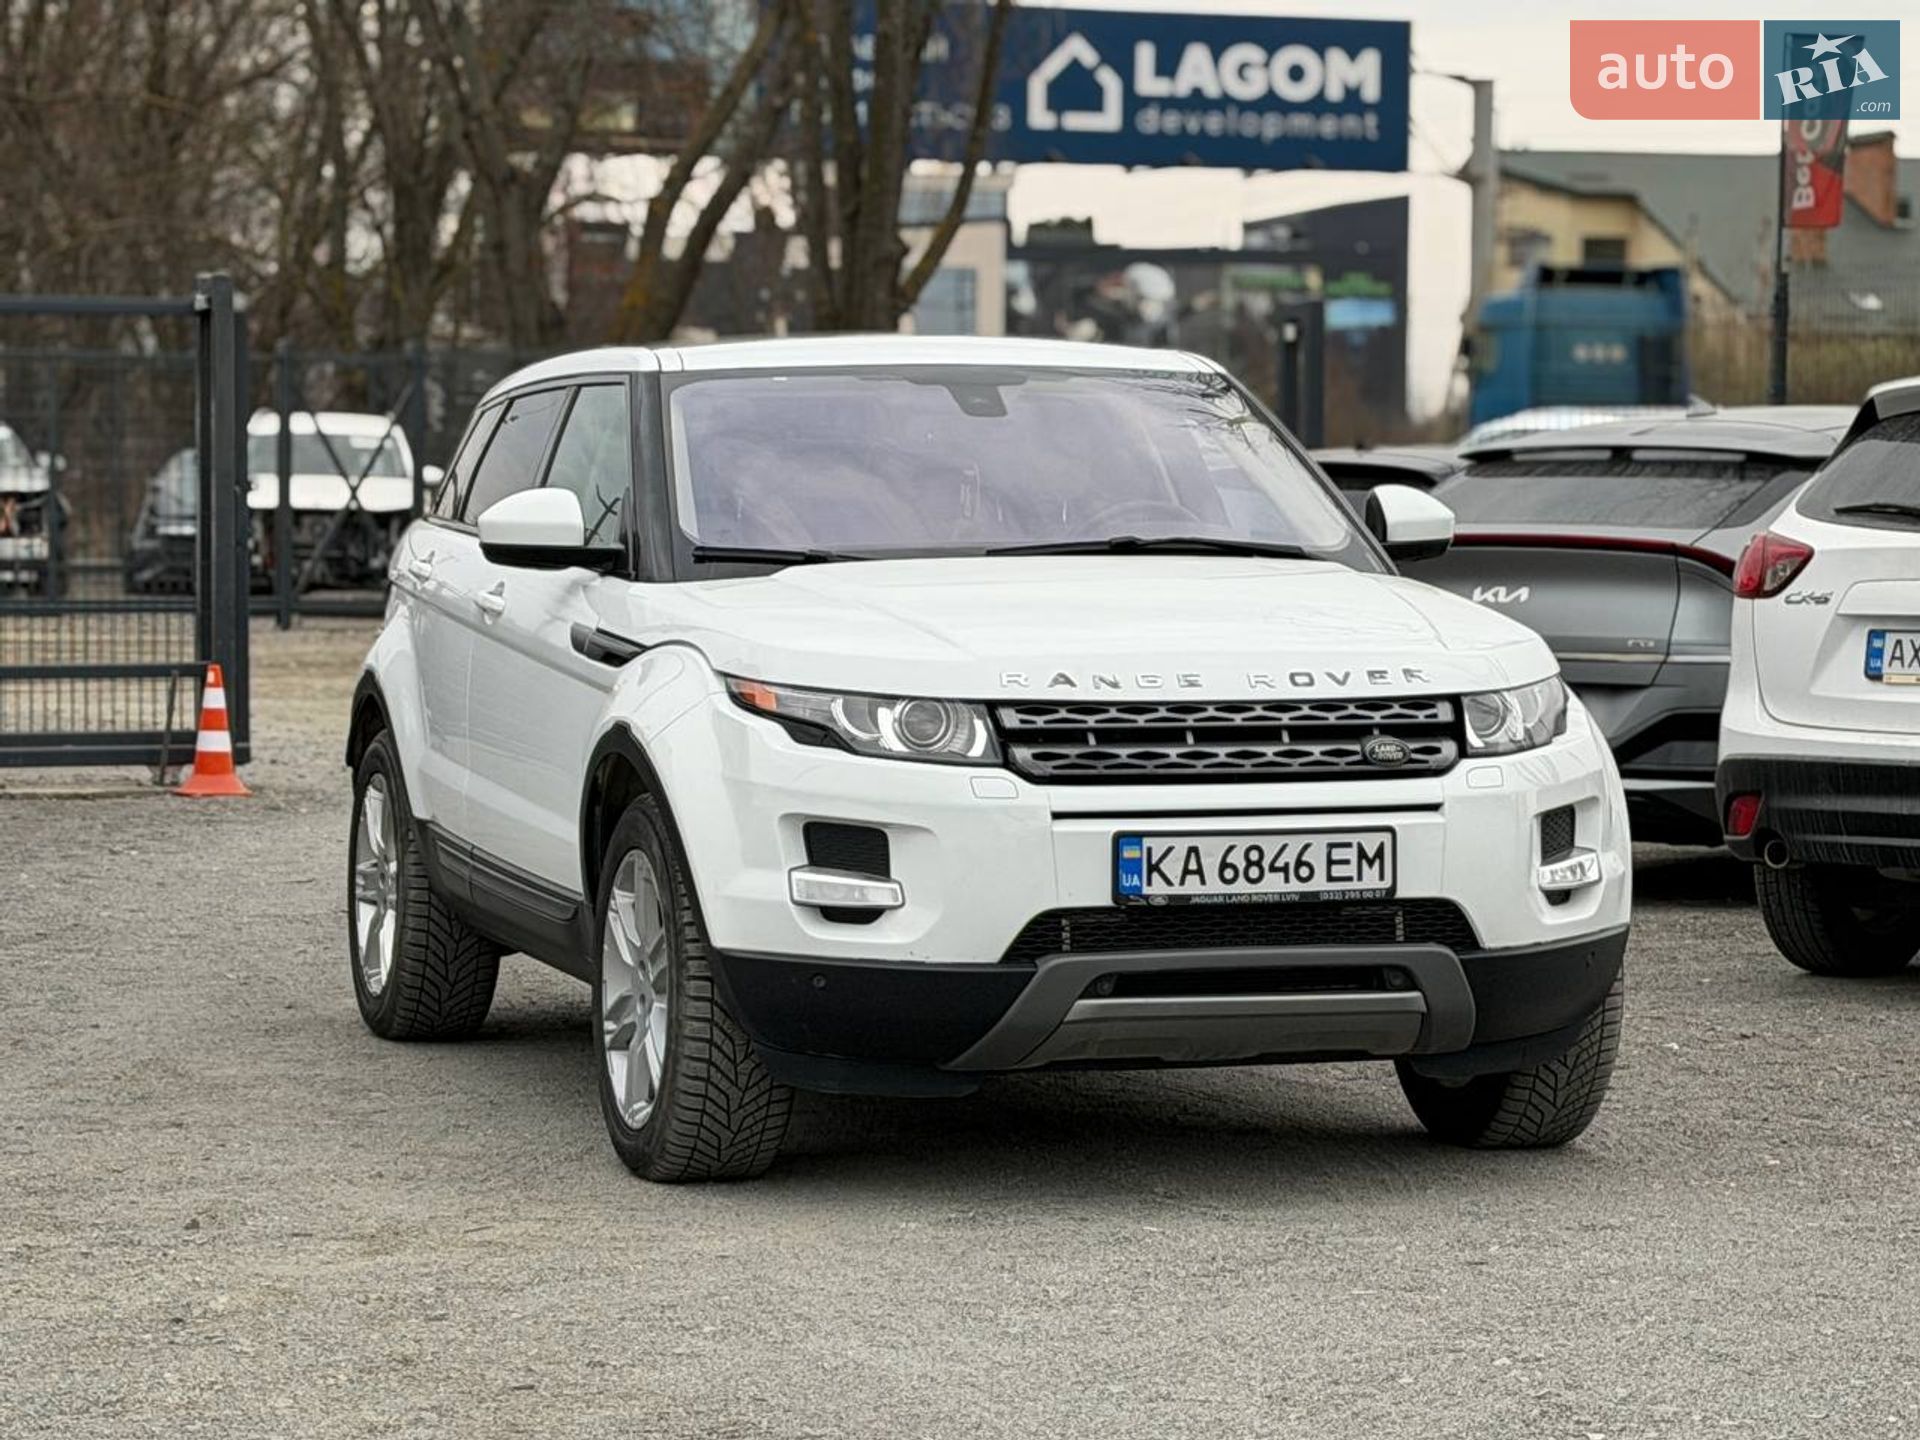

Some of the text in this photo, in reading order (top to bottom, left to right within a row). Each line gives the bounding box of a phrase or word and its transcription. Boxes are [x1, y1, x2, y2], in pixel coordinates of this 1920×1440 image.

[1134, 40, 1382, 103] LAGOM
[1134, 103, 1380, 144] development
[999, 668, 1431, 690] RANGE ROVER
[1145, 841, 1385, 887] KA 6846 EM
[1122, 874, 1141, 888] UA
[1190, 894, 1224, 904] JAGUAR
[1226, 894, 1250, 904] LAND
[1251, 893, 1280, 903] ROVER
